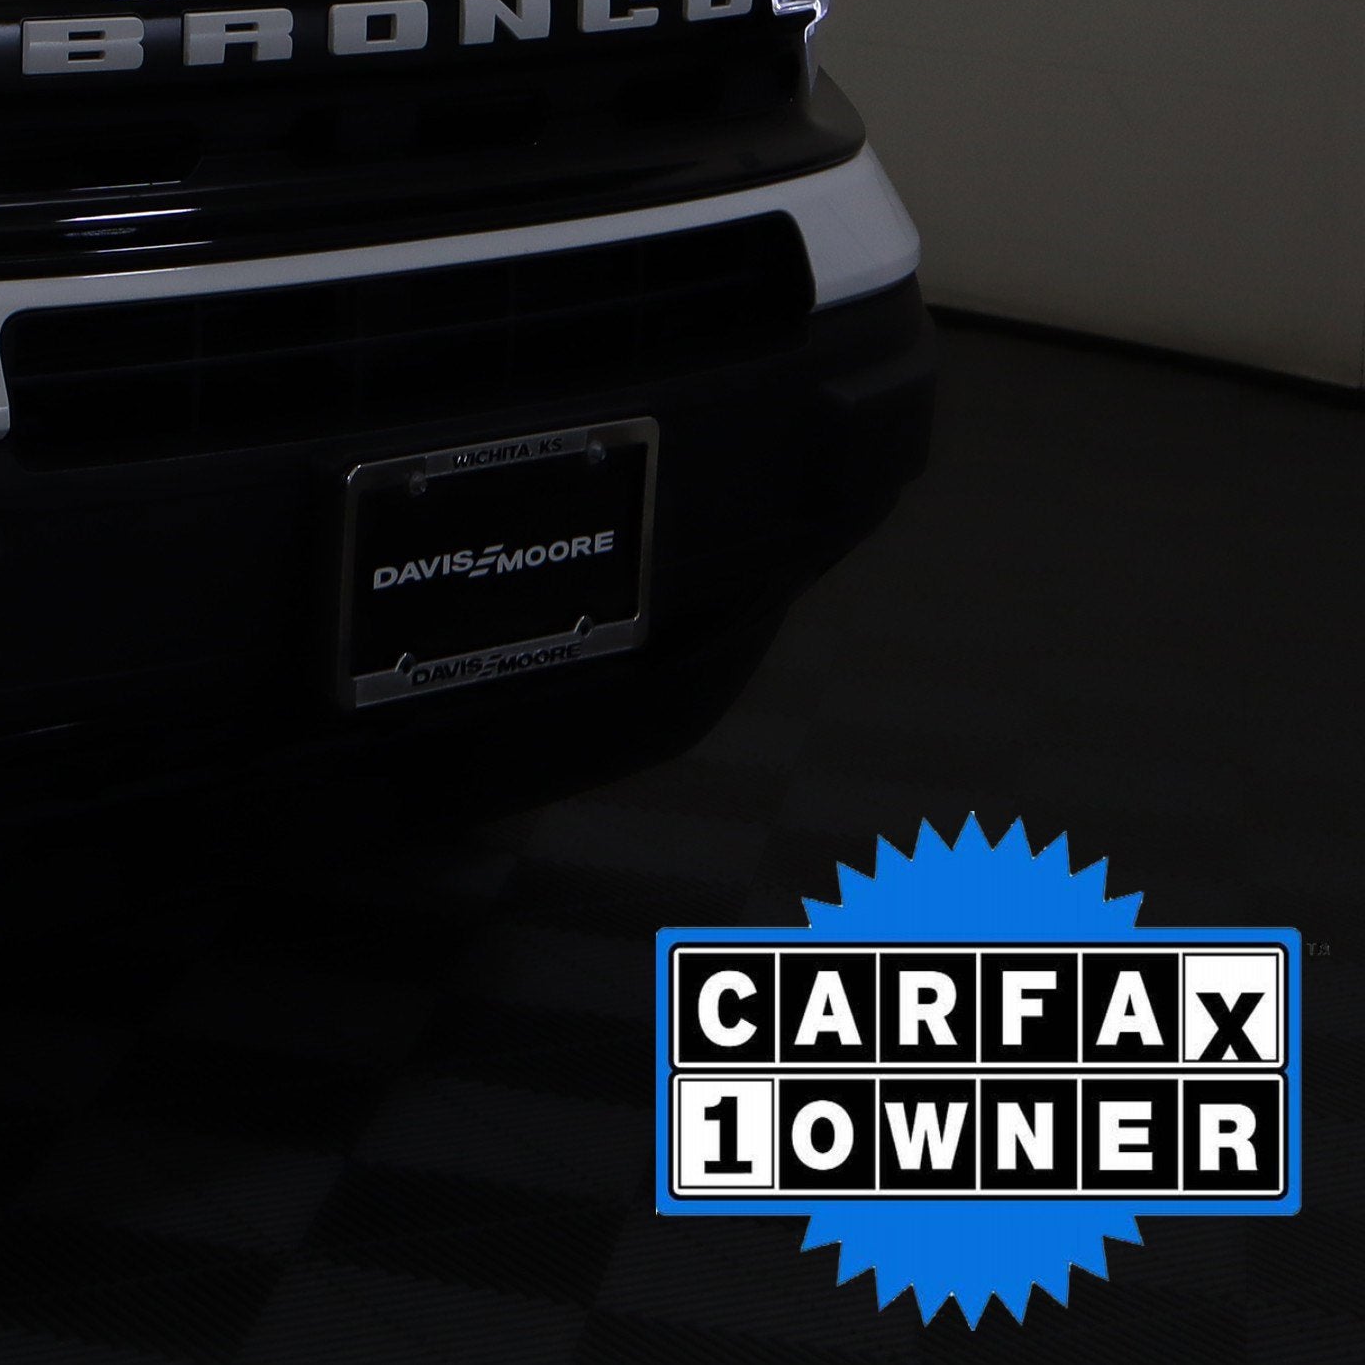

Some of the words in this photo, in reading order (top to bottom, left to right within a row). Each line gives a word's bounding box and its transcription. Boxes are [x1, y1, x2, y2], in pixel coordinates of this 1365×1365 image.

[539, 438, 563, 455] KS
[372, 549, 475, 591] DAVIS
[496, 529, 615, 575] MOORE
[412, 656, 482, 685] DAVIS
[497, 641, 582, 674] MOORE
